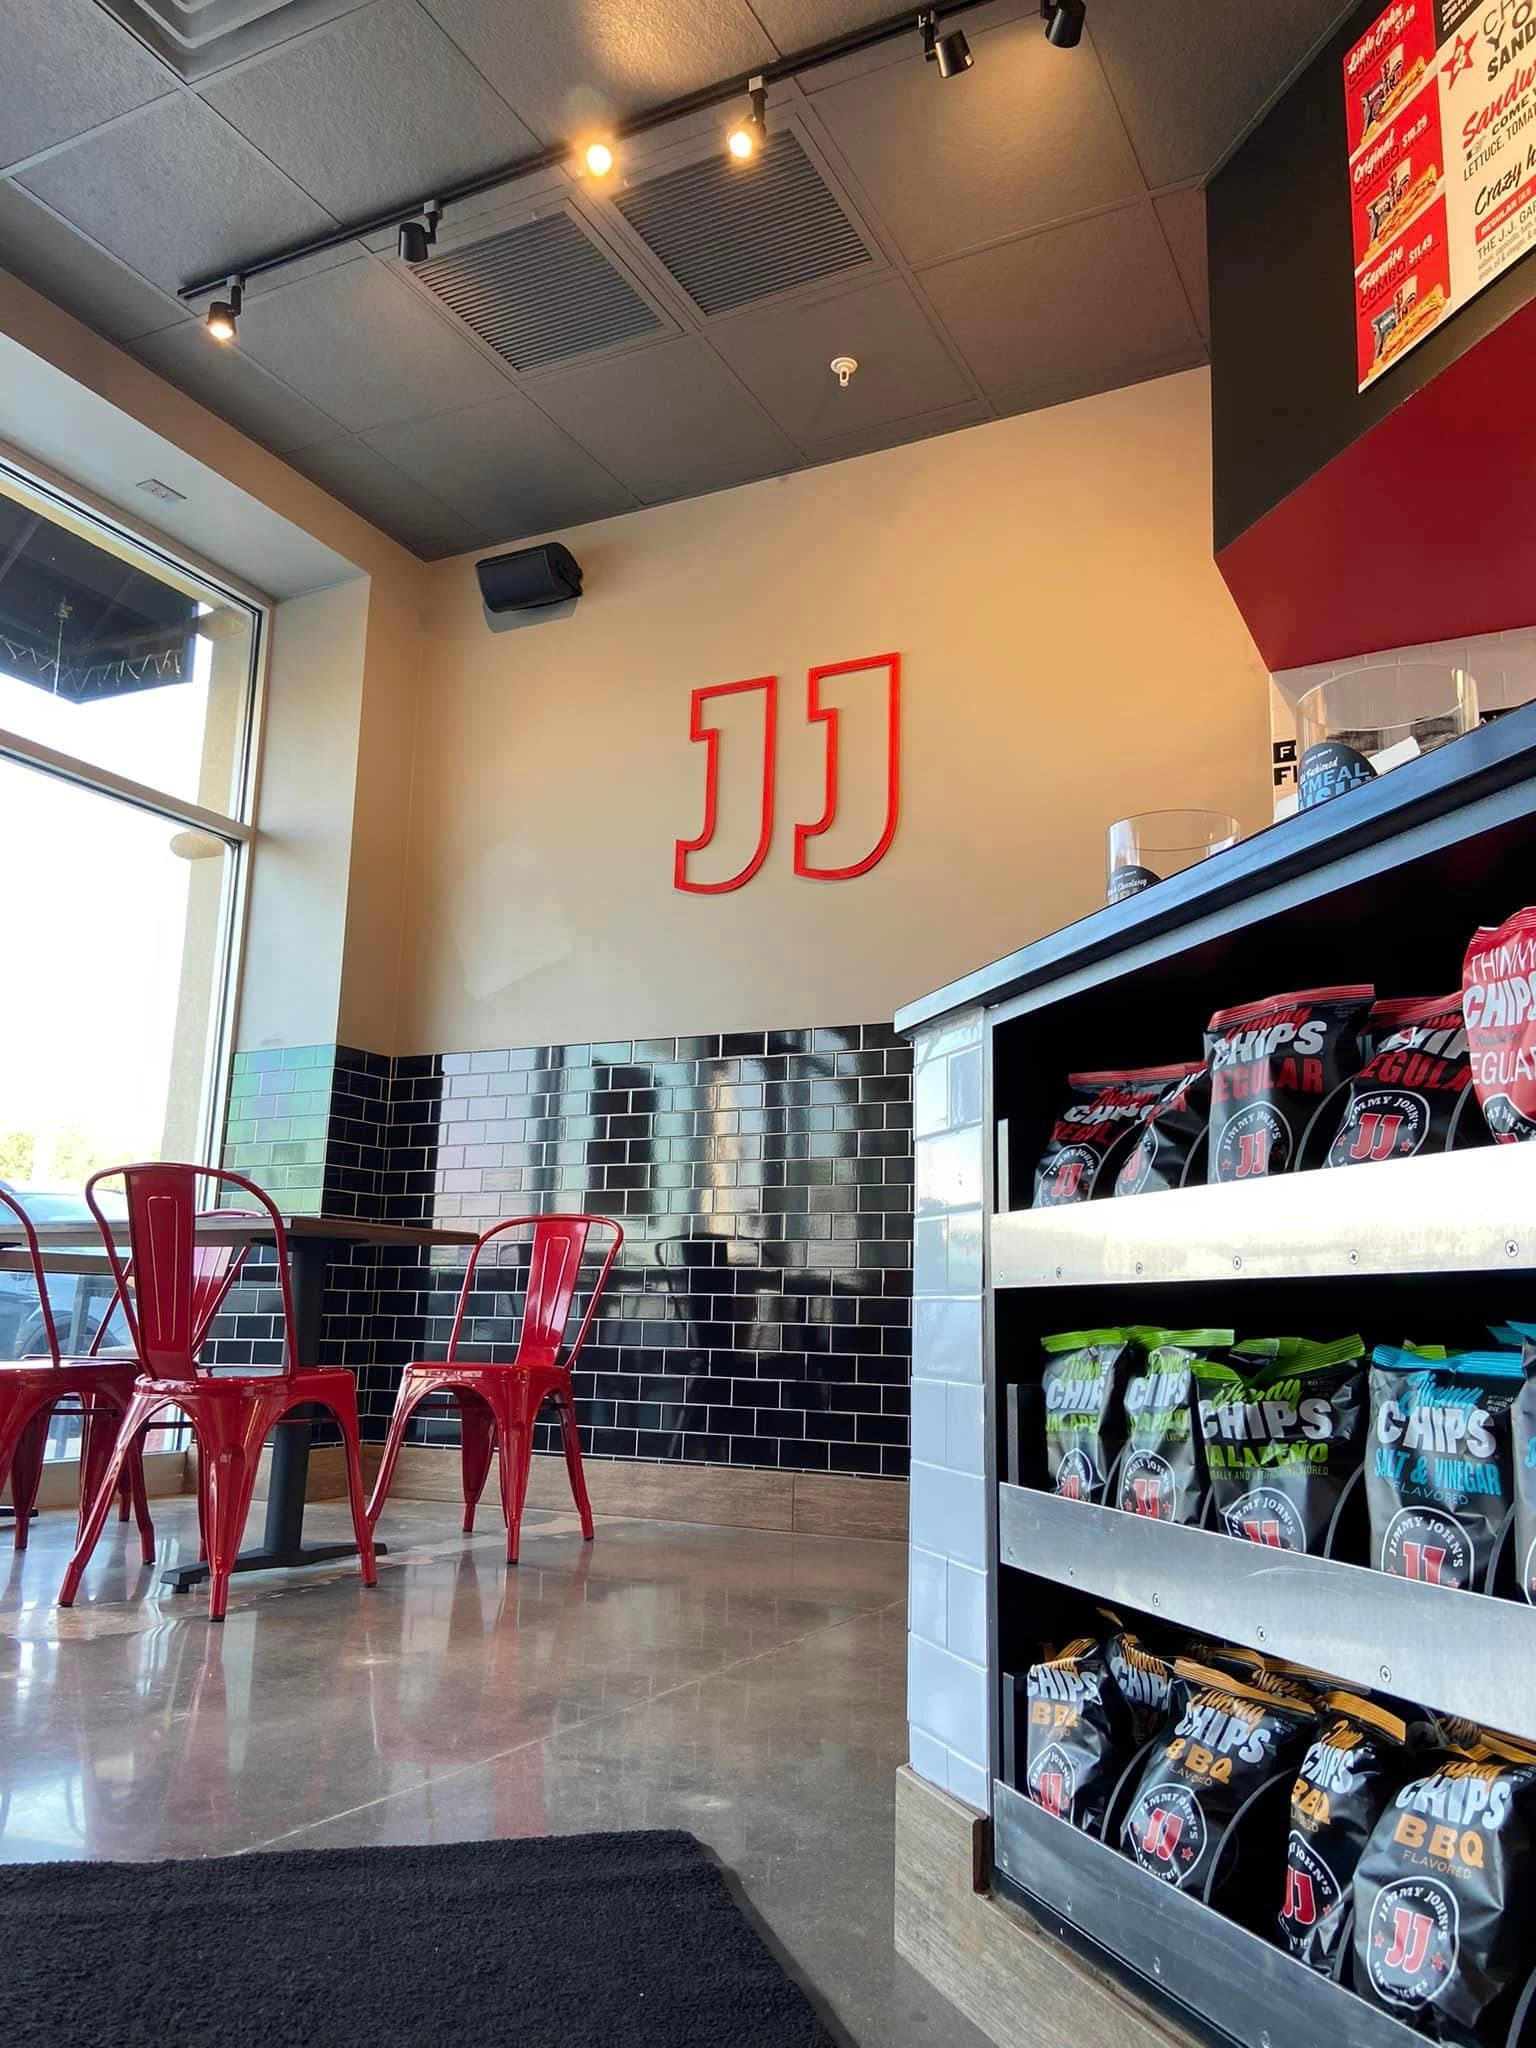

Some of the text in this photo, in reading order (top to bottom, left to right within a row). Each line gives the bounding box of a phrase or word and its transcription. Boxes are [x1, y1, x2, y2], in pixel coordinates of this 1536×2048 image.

[1492, 94, 1529, 135] COME
[1354, 127, 1395, 184] Original
[1355, 145, 1400, 195] COMBO
[1463, 136, 1505, 182] LETTUCE,
[1474, 161, 1522, 215] Crazy
[1359, 245, 1404, 295] Favorite
[1478, 236, 1497, 260] THE
[1360, 260, 1406, 309] COMBO
[674, 651, 900, 895] JJ
[1212, 1021, 1327, 1070] CHIPS
[1213, 1056, 1324, 1103] EGULAR
[1223, 1115, 1254, 1151] JIMMY
[1350, 1112, 1404, 1161] JJ
[1393, 1098, 1418, 1131] JOHN'S
[1235, 1128, 1268, 1178] JJ
[1051, 1162, 1085, 1197] JJ
[1199, 1398, 1334, 1440] CHIPS
[1378, 1400, 1497, 1459] CHIPS
[1375, 1447, 1502, 1495] SALT & VINEGAR
[1392, 1481, 1470, 1505] FLAVORED
[1262, 1497, 1297, 1535] JOHN'S
[1388, 1516, 1464, 1568] JIMMY JOHN'S
[1174, 1701, 1272, 1764] CHIPS
[1166, 1737, 1233, 1785] BBQ
[1395, 1773, 1511, 1830] CHIPS
[1143, 1807, 1184, 1862] JJ
[1394, 1813, 1485, 1869] BBQ
[1402, 1849, 1472, 1880] FLAVORED
[1379, 1886, 1449, 1941] JIMMY JOHN'S
[1384, 1906, 1434, 1974] JJ
